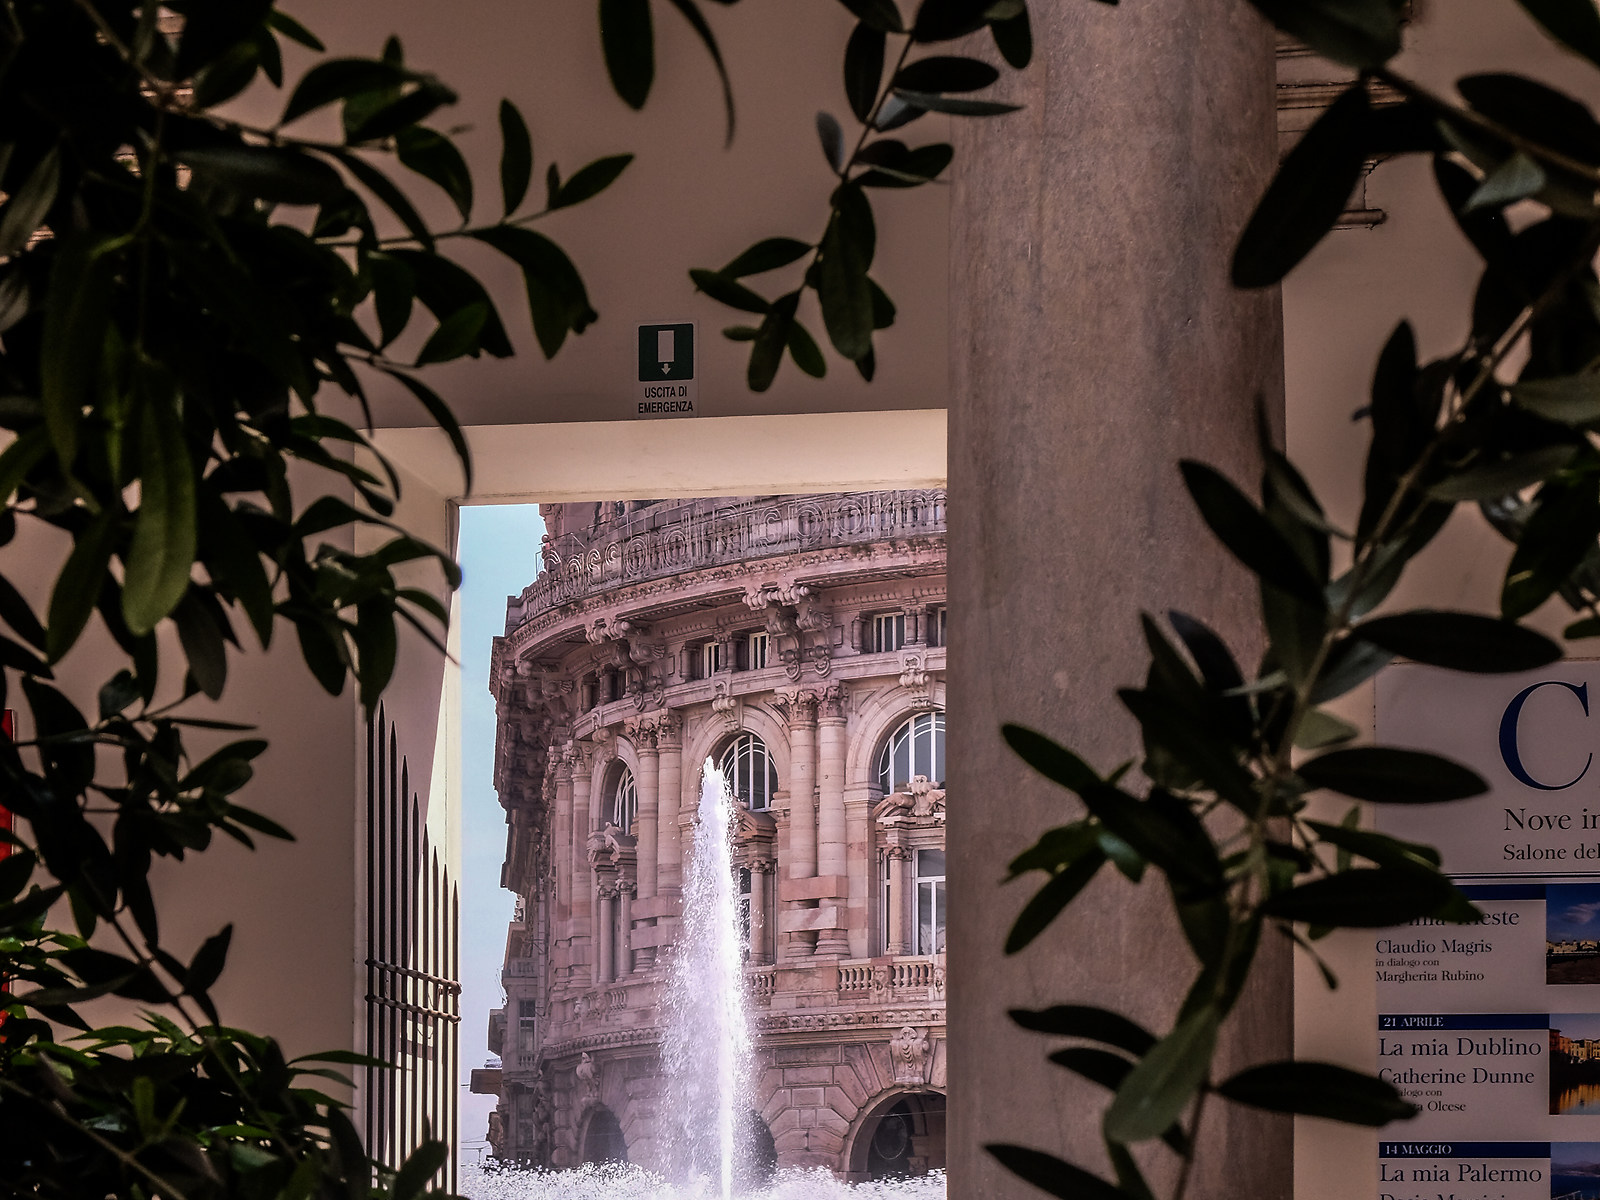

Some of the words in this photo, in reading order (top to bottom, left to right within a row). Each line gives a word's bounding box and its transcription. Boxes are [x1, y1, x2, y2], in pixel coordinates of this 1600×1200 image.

[645, 386, 676, 398] USCITA
[679, 386, 687, 397] DI
[638, 401, 694, 413] EMERGENZA
[1499, 681, 1593, 791] C
[1504, 808, 1572, 831] Nove
[1504, 844, 1567, 860] Salone
[1376, 940, 1436, 954] Claudio
[1442, 939, 1492, 955] Magris
[1376, 958, 1385, 967] in
[1387, 957, 1421, 968] dialogo
[1376, 971, 1437, 984] Margherita
[1442, 970, 1485, 982] Rubino
[1384, 1017, 1396, 1027] 21
[1401, 1017, 1444, 1027] APRILE
[1379, 1038, 1403, 1056] La
[1412, 1038, 1448, 1056] mia
[1457, 1037, 1542, 1056] Dublino
[1473, 1067, 1535, 1084] Dunne
[1427, 1100, 1467, 1112] Olcese
[1385, 1144, 1398, 1155] 14
[1401, 1144, 1452, 1155] MAGGIO
[1380, 1164, 1404, 1182] La
[1413, 1164, 1449, 1182] mia
[1458, 1164, 1542, 1183] Palermo
